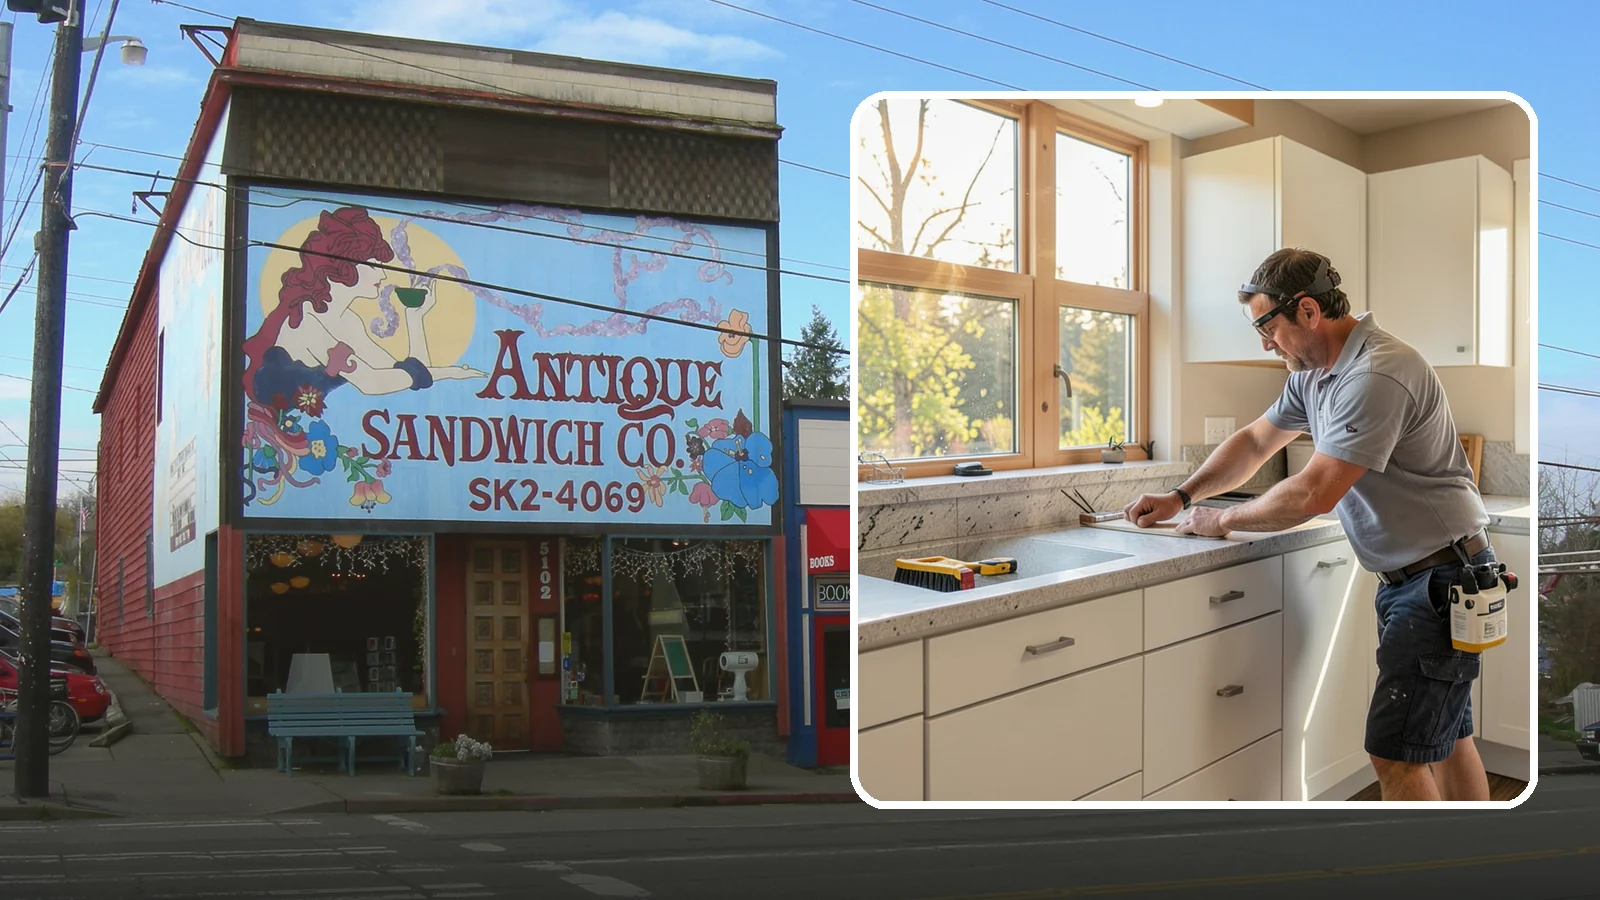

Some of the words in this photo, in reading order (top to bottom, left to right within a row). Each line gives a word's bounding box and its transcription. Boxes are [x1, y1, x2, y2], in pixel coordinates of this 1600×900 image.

[476, 329, 724, 421] ANTIQUE
[361, 408, 604, 467] SANDWICH
[617, 421, 685, 469] CO.
[468, 477, 645, 513] SK2-4069
[539, 541, 552, 600] 5102
[809, 555, 835, 569] BOOKS
